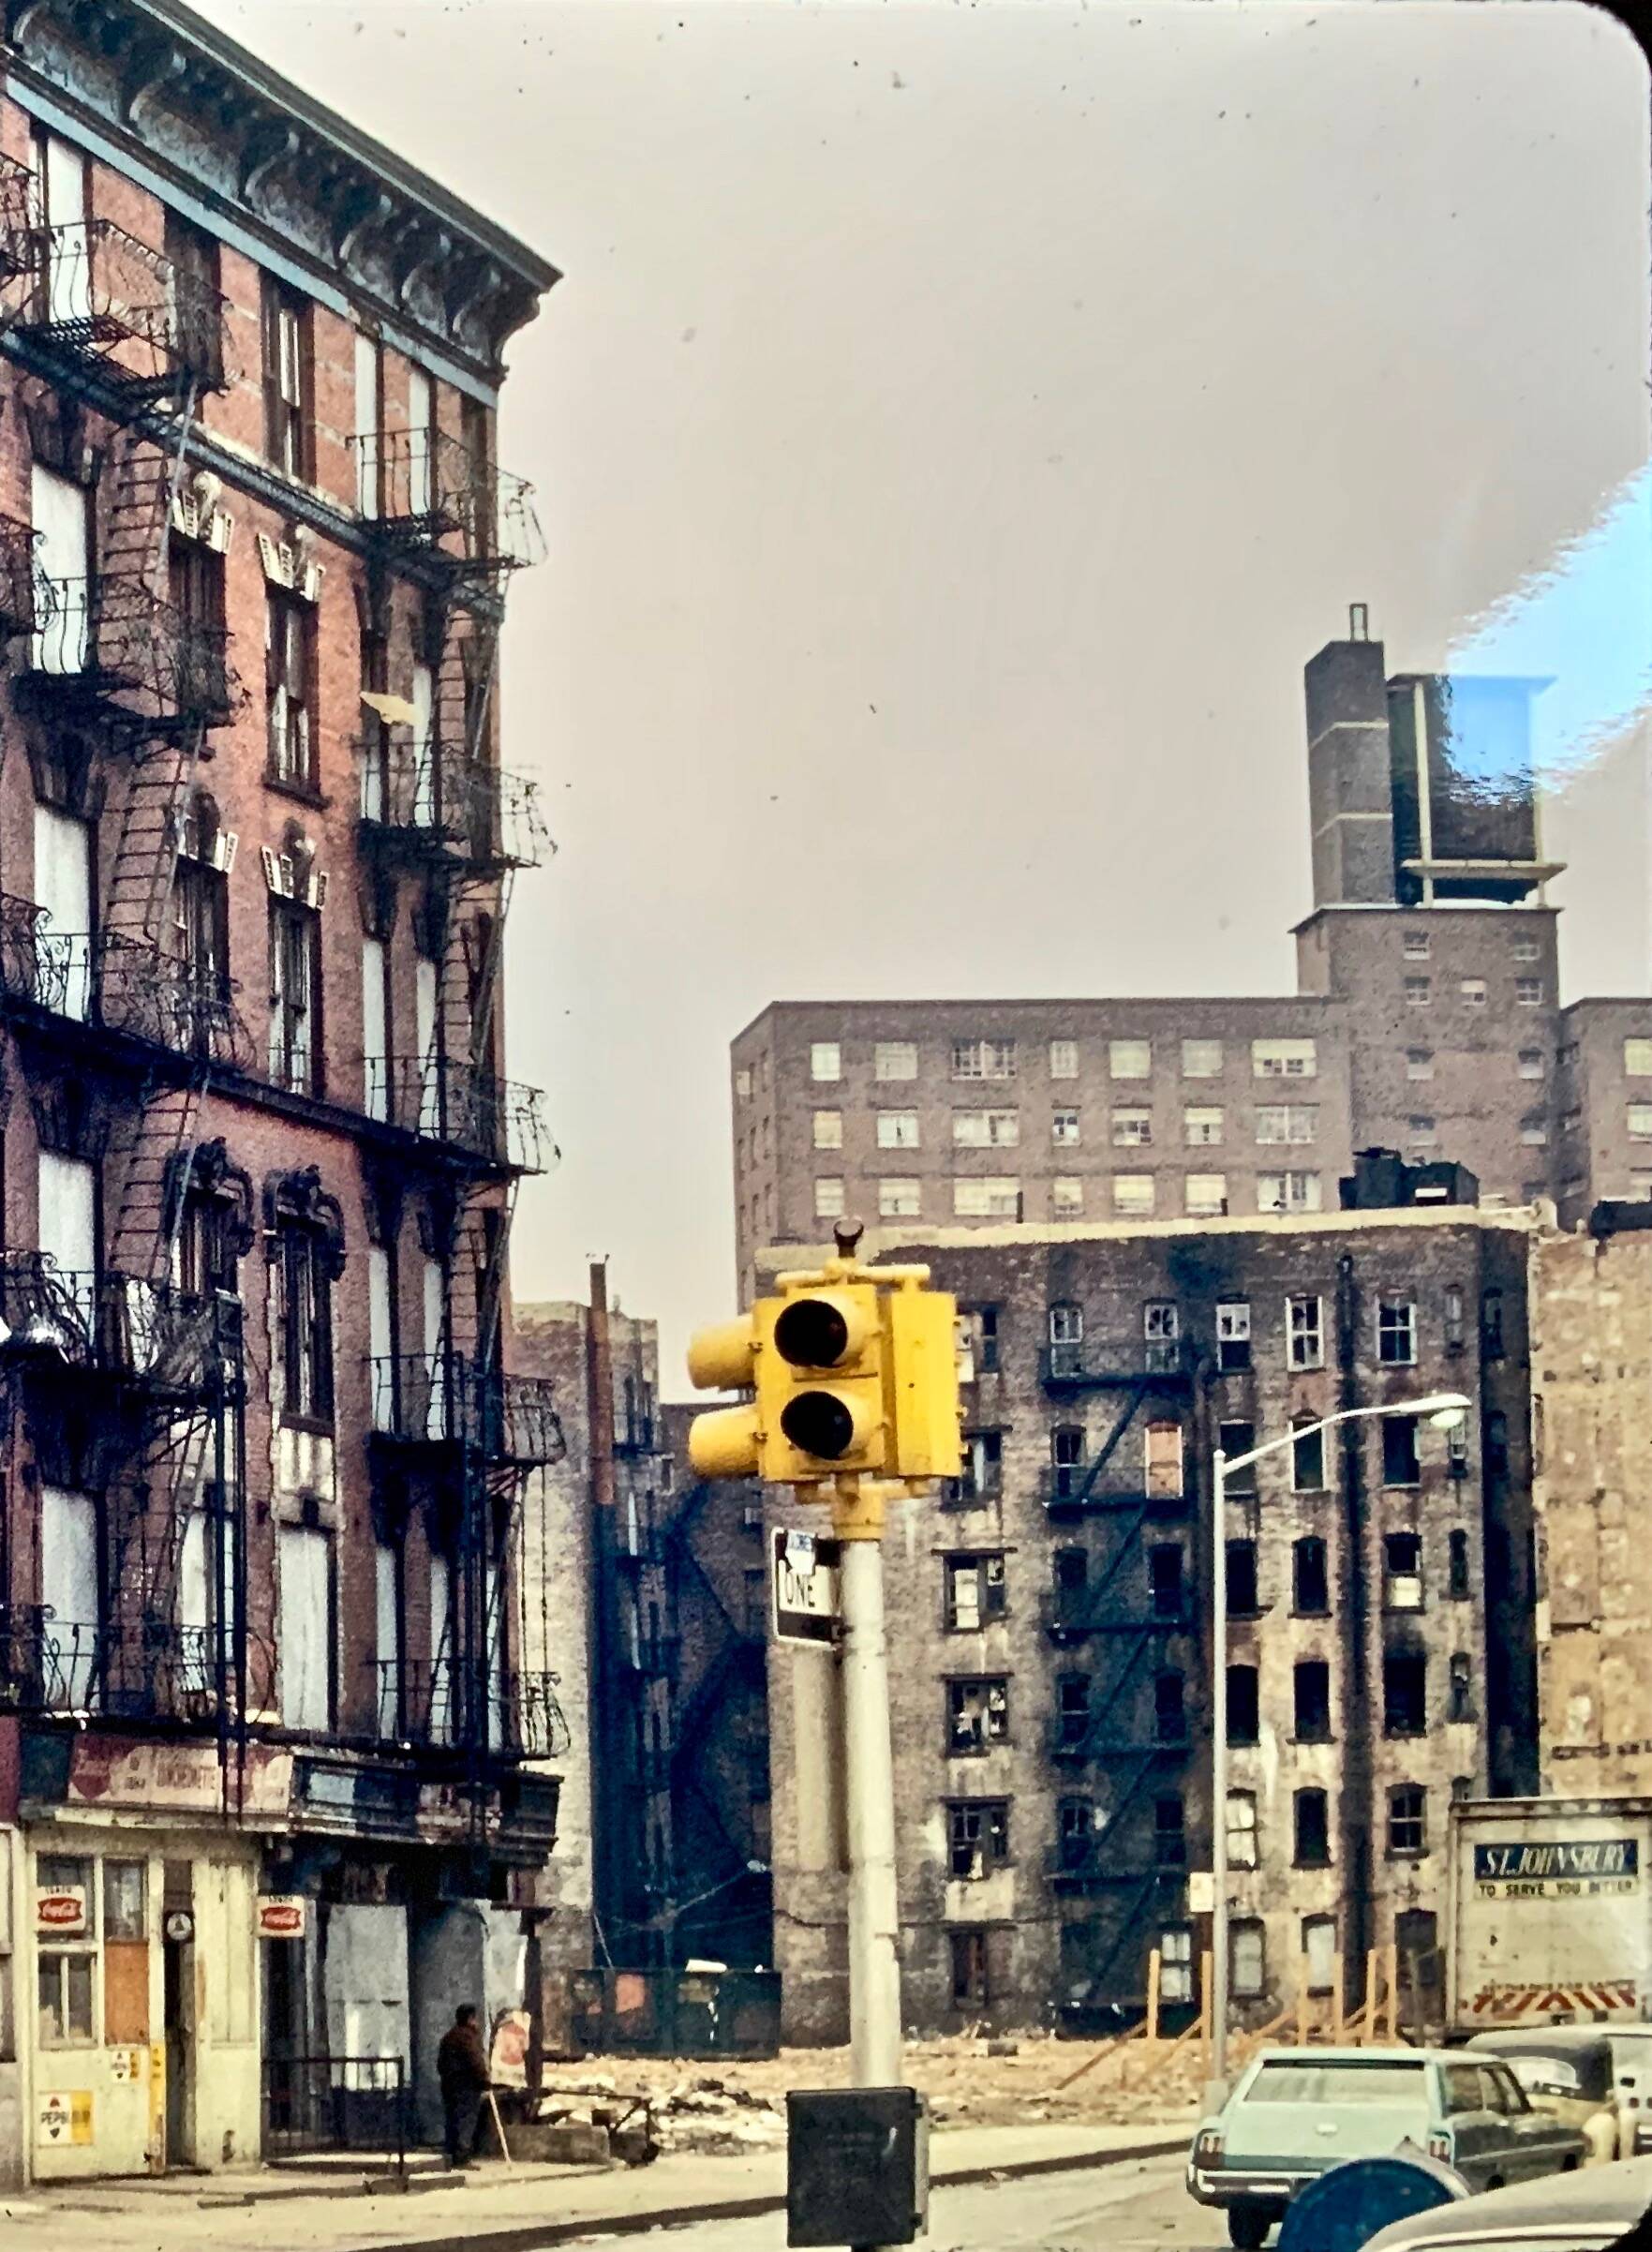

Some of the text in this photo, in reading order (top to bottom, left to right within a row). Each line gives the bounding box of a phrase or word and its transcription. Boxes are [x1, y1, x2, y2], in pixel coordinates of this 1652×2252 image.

[784, 1573, 816, 1609] ONE
[1479, 1884, 1496, 1898] TO
[1505, 1882, 1545, 1897] SERVE
[1556, 1881, 1582, 1896] YOU
